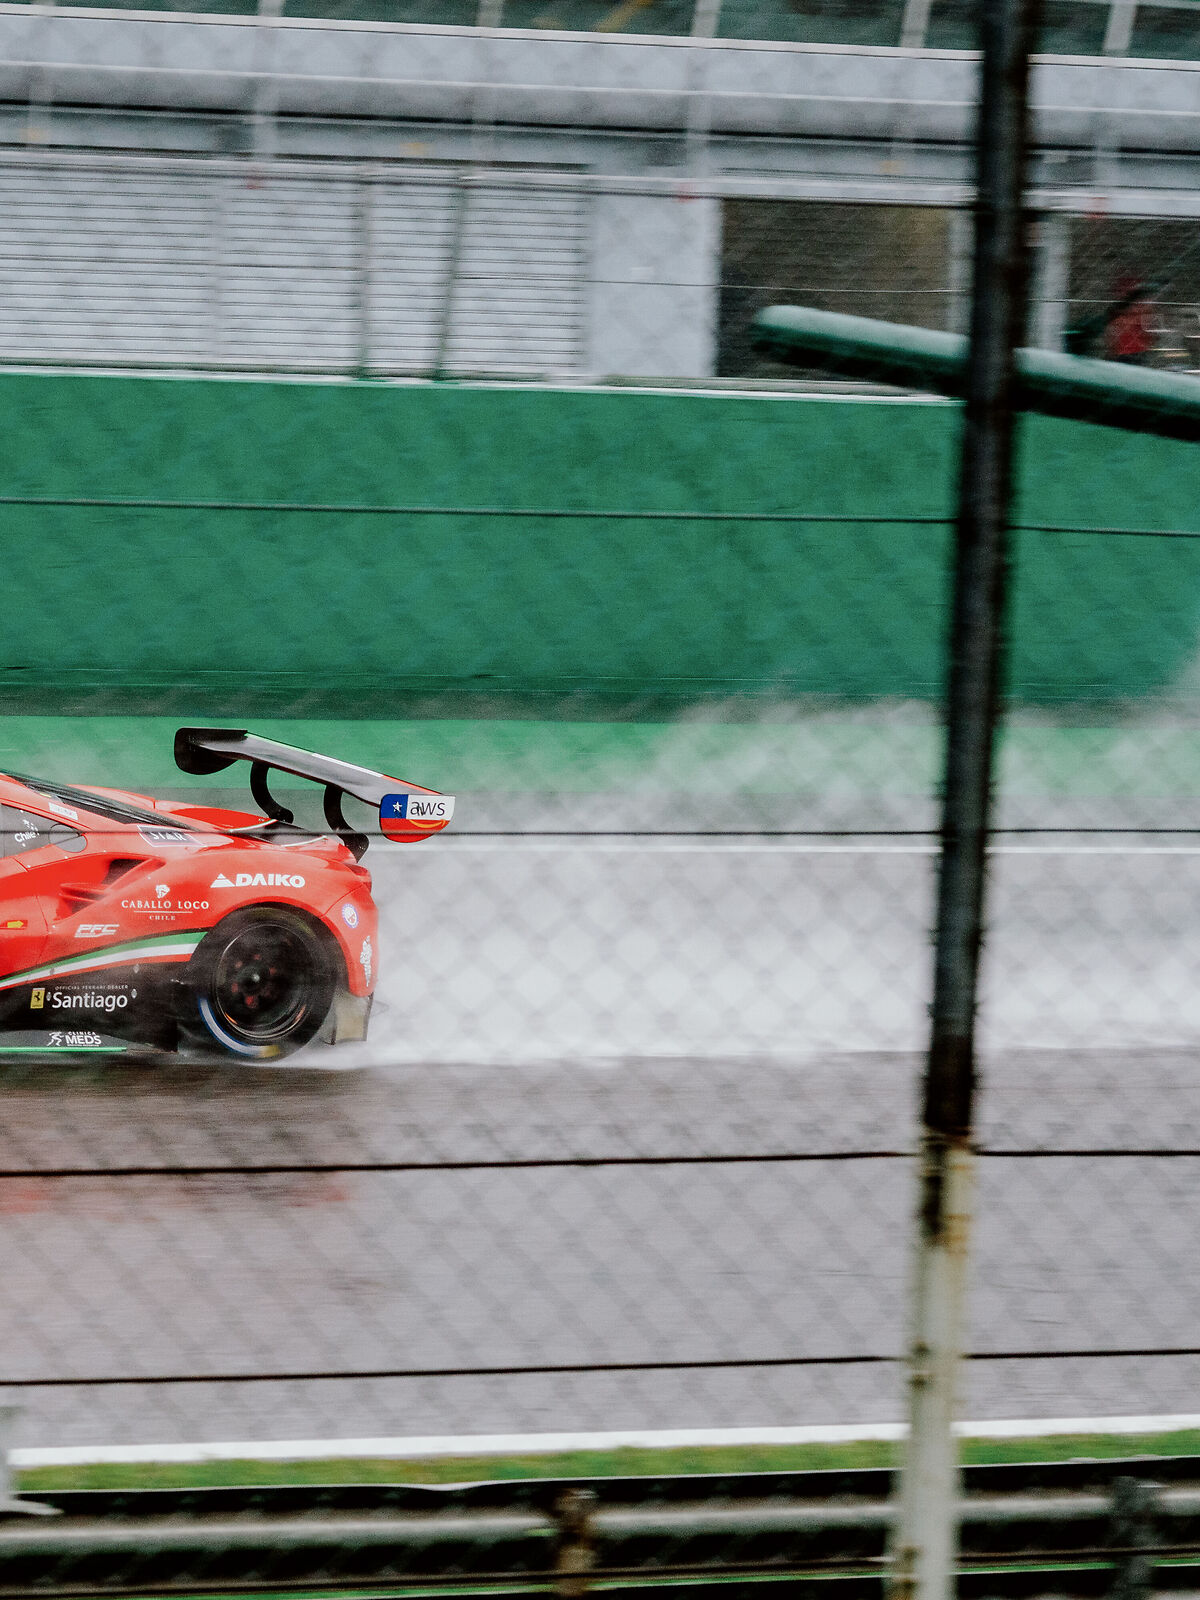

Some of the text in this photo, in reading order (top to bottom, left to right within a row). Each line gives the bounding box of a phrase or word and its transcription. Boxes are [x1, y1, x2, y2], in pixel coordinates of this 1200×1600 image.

[410, 801, 445, 816] aws
[235, 873, 306, 888] DAIKO
[121, 899, 210, 910] CABALLO LOCO
[51, 991, 128, 1012] Santiago
[65, 1035, 102, 1045] MEDS
